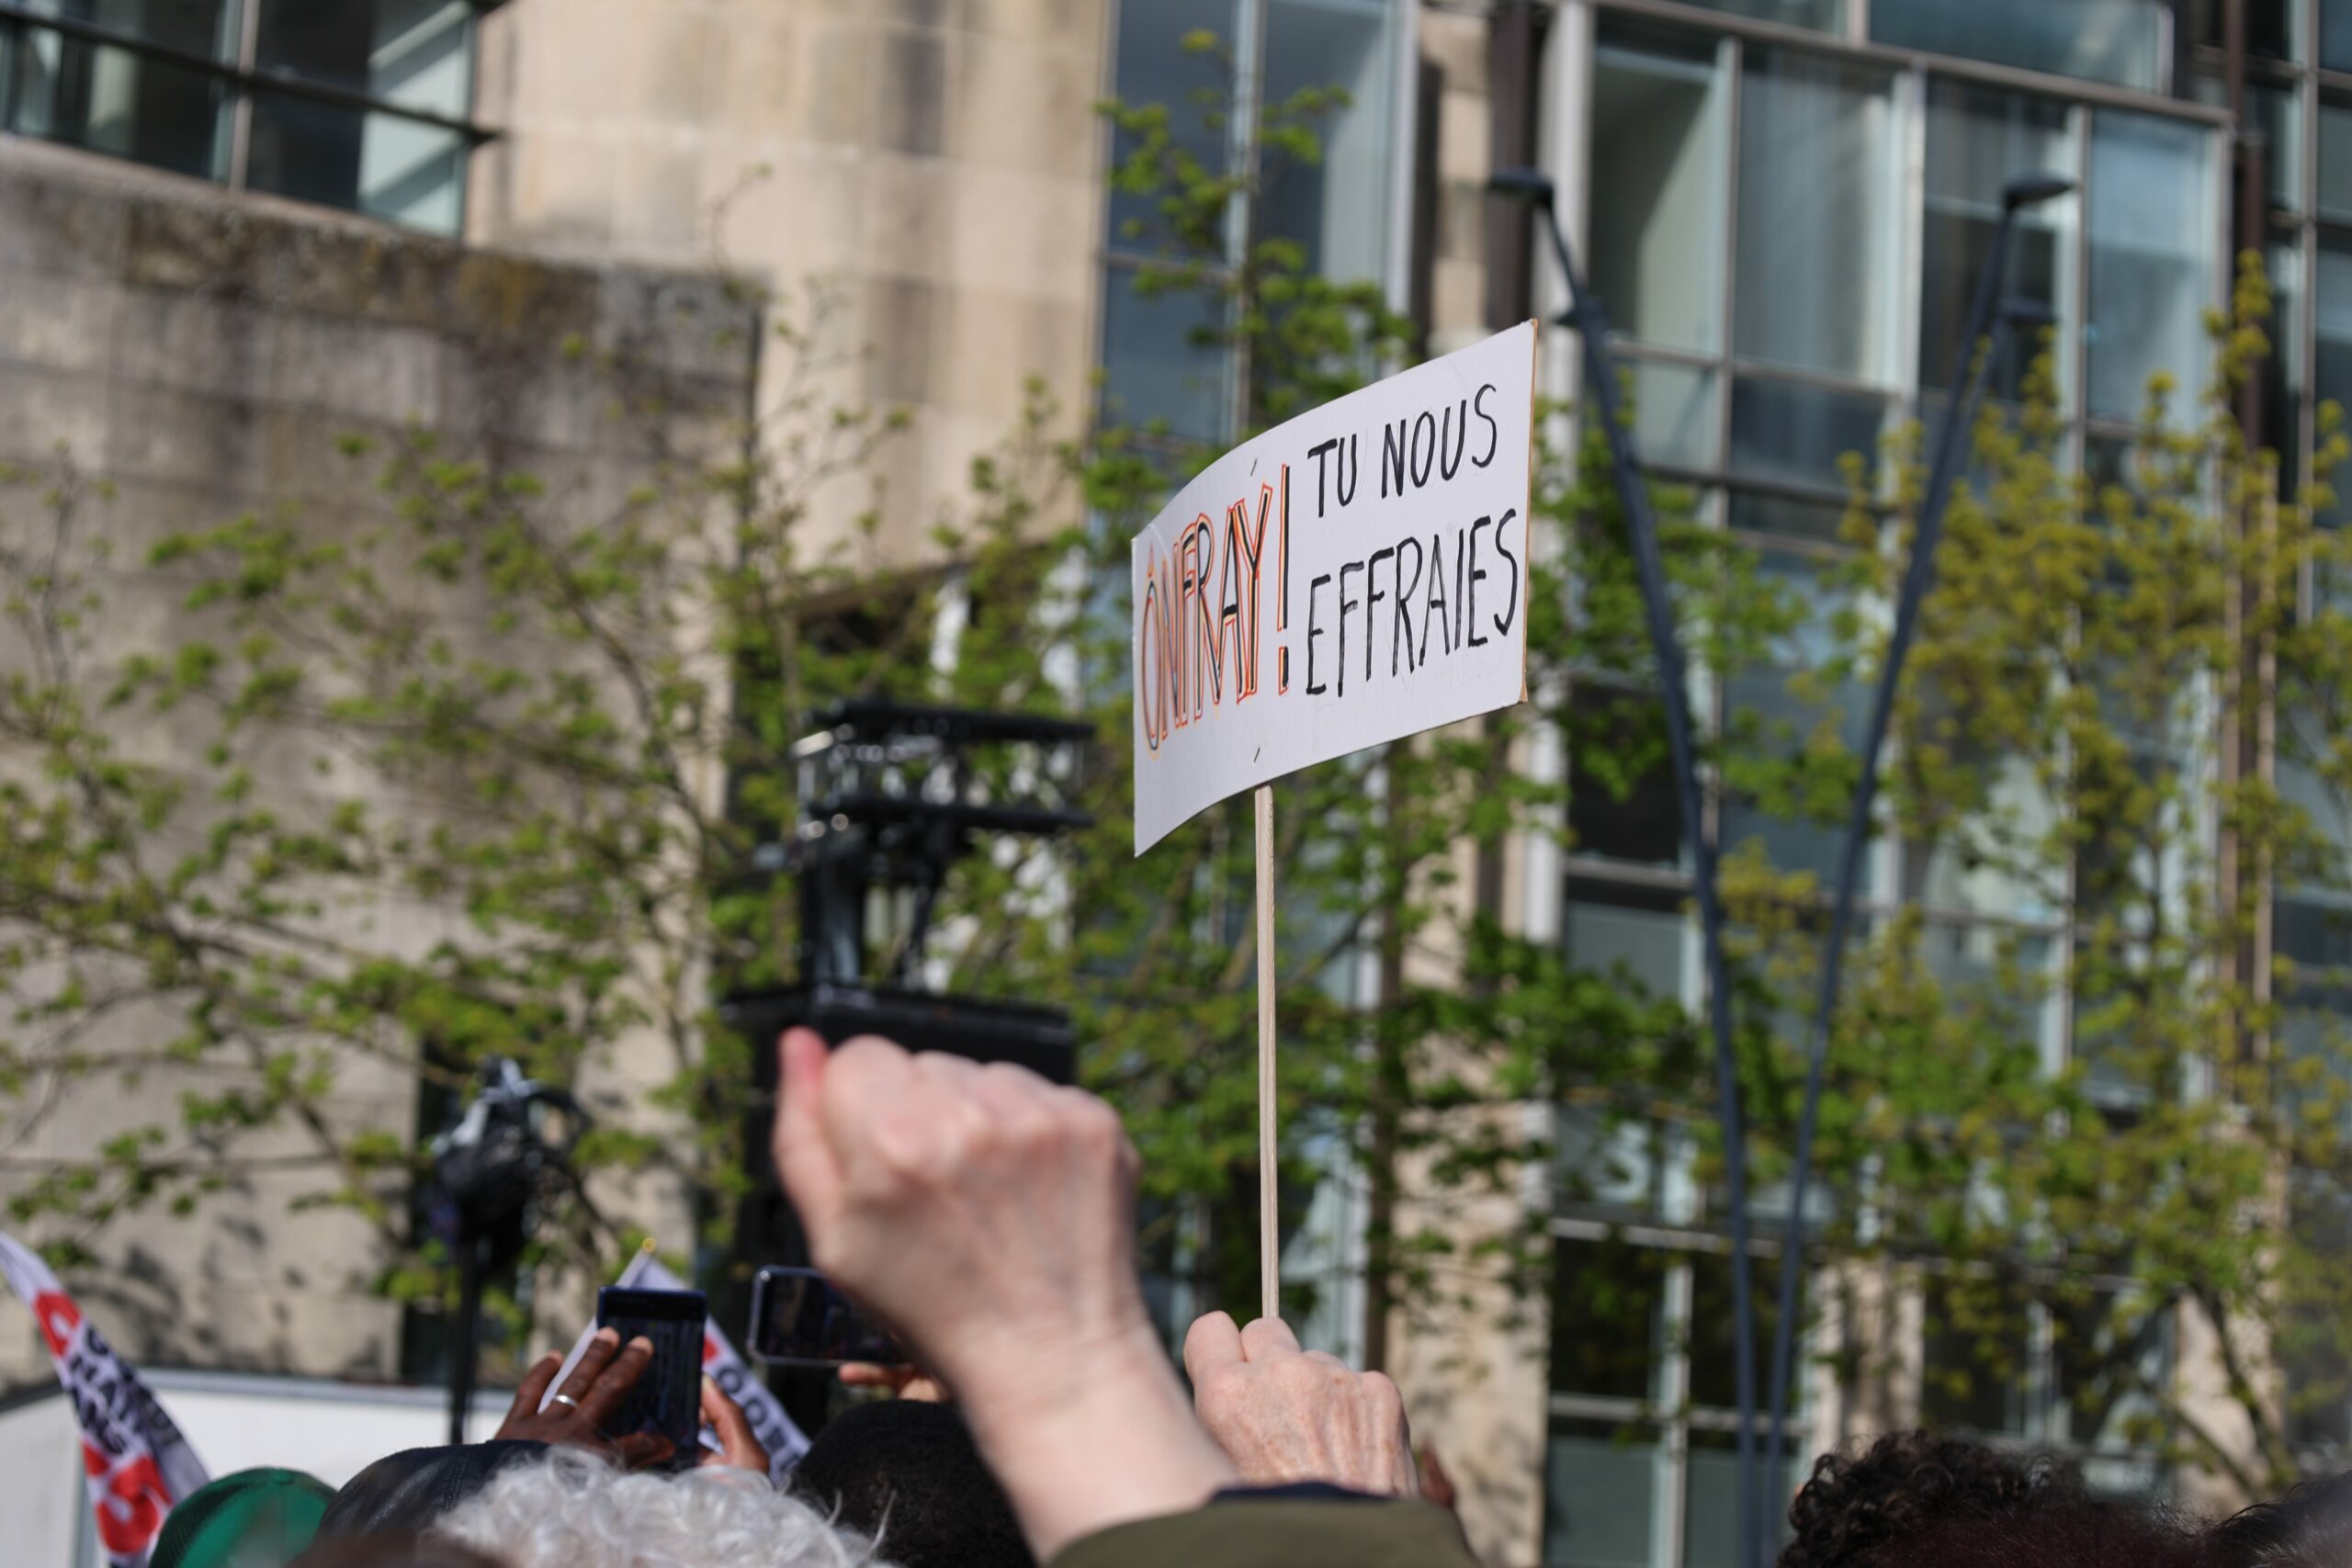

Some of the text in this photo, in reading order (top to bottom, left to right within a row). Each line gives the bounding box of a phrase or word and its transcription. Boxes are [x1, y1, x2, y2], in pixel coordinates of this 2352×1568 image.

[1307, 383, 1497, 518] TU NOUS
[1306, 508, 1518, 698] EFFRAIES
